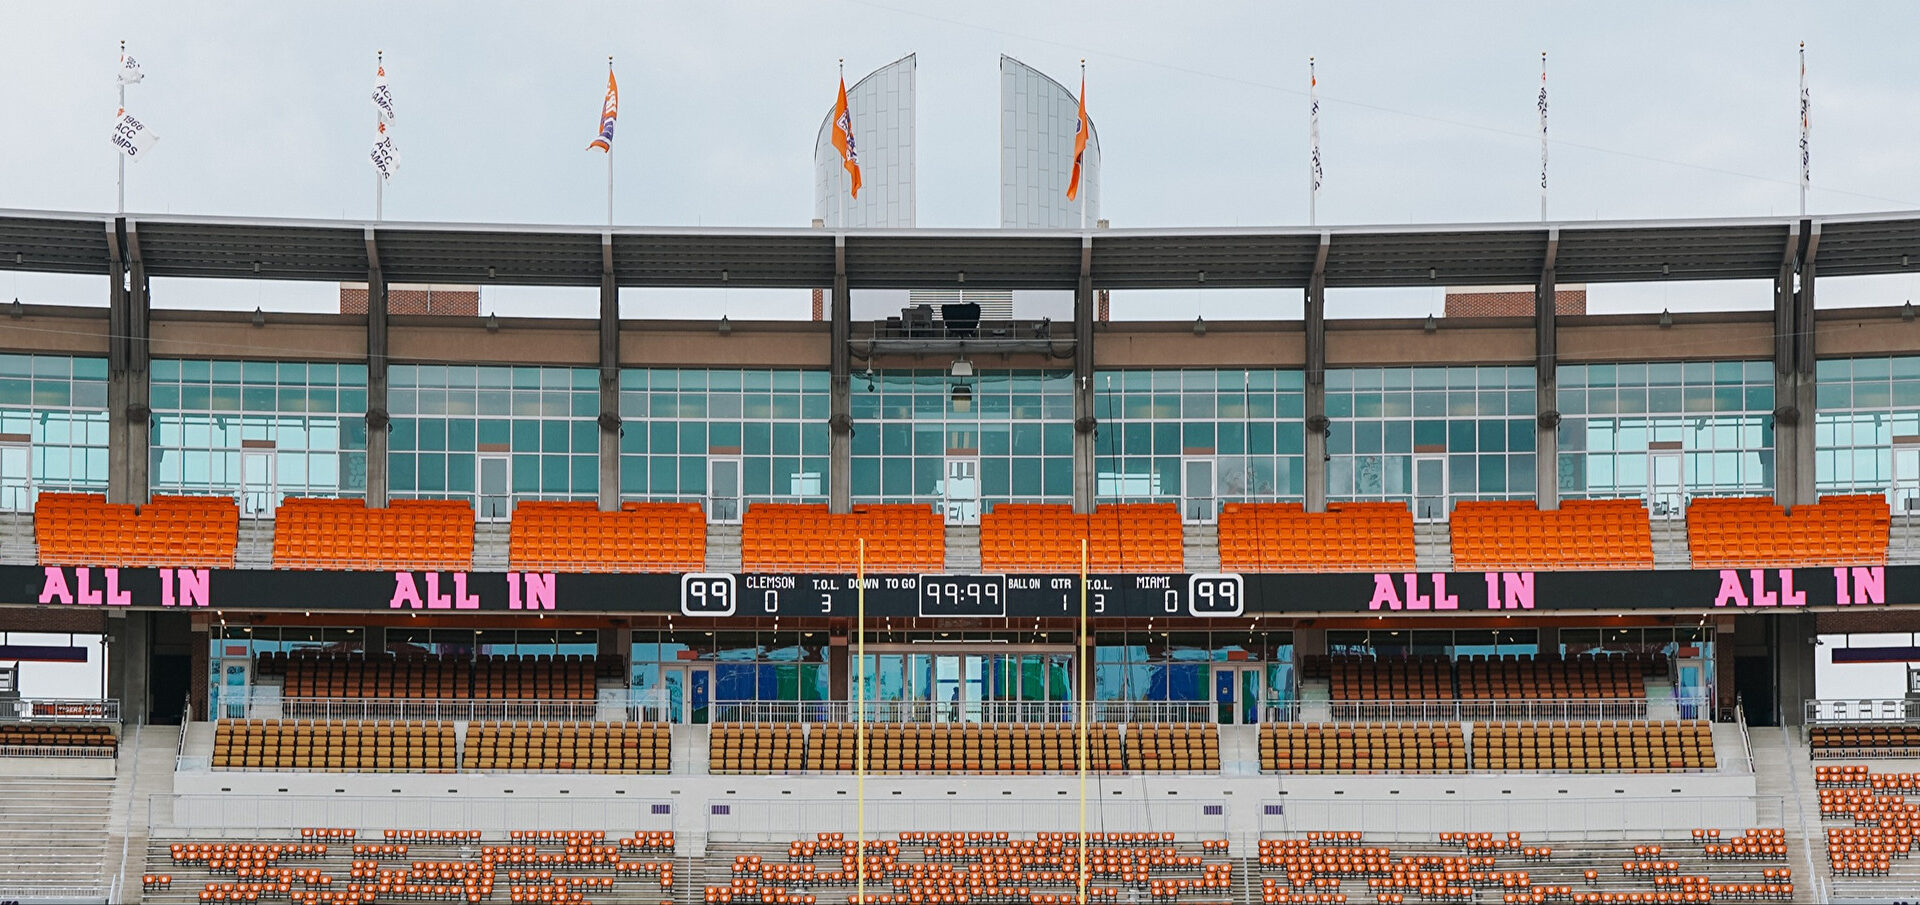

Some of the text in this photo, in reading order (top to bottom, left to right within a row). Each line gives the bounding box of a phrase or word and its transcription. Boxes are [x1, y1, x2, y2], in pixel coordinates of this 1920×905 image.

[115, 122, 136, 139] ACC
[376, 142, 393, 165] ACC
[39, 567, 209, 605] ALL IN
[391, 573, 555, 609] ALL IN
[746, 576, 795, 589] CLEMSON
[812, 579, 839, 590] T.O.L.
[886, 578, 916, 589] TO GO
[1008, 578, 1041, 589] BALL ON
[1051, 578, 1072, 589] QTR
[1086, 579, 1112, 590] T.O.L.
[1136, 576, 1170, 589] MIAMI
[1370, 573, 1533, 609] ALL IN
[1715, 567, 1885, 606] ALL IN
[691, 581, 727, 607] 99
[765, 589, 778, 613] 0
[821, 593, 832, 613] 3
[927, 583, 998, 605] 99:99
[1063, 594, 1067, 611] 1
[1094, 594, 1105, 613] 3
[1165, 589, 1178, 613] 0
[1198, 581, 1235, 607] 99
